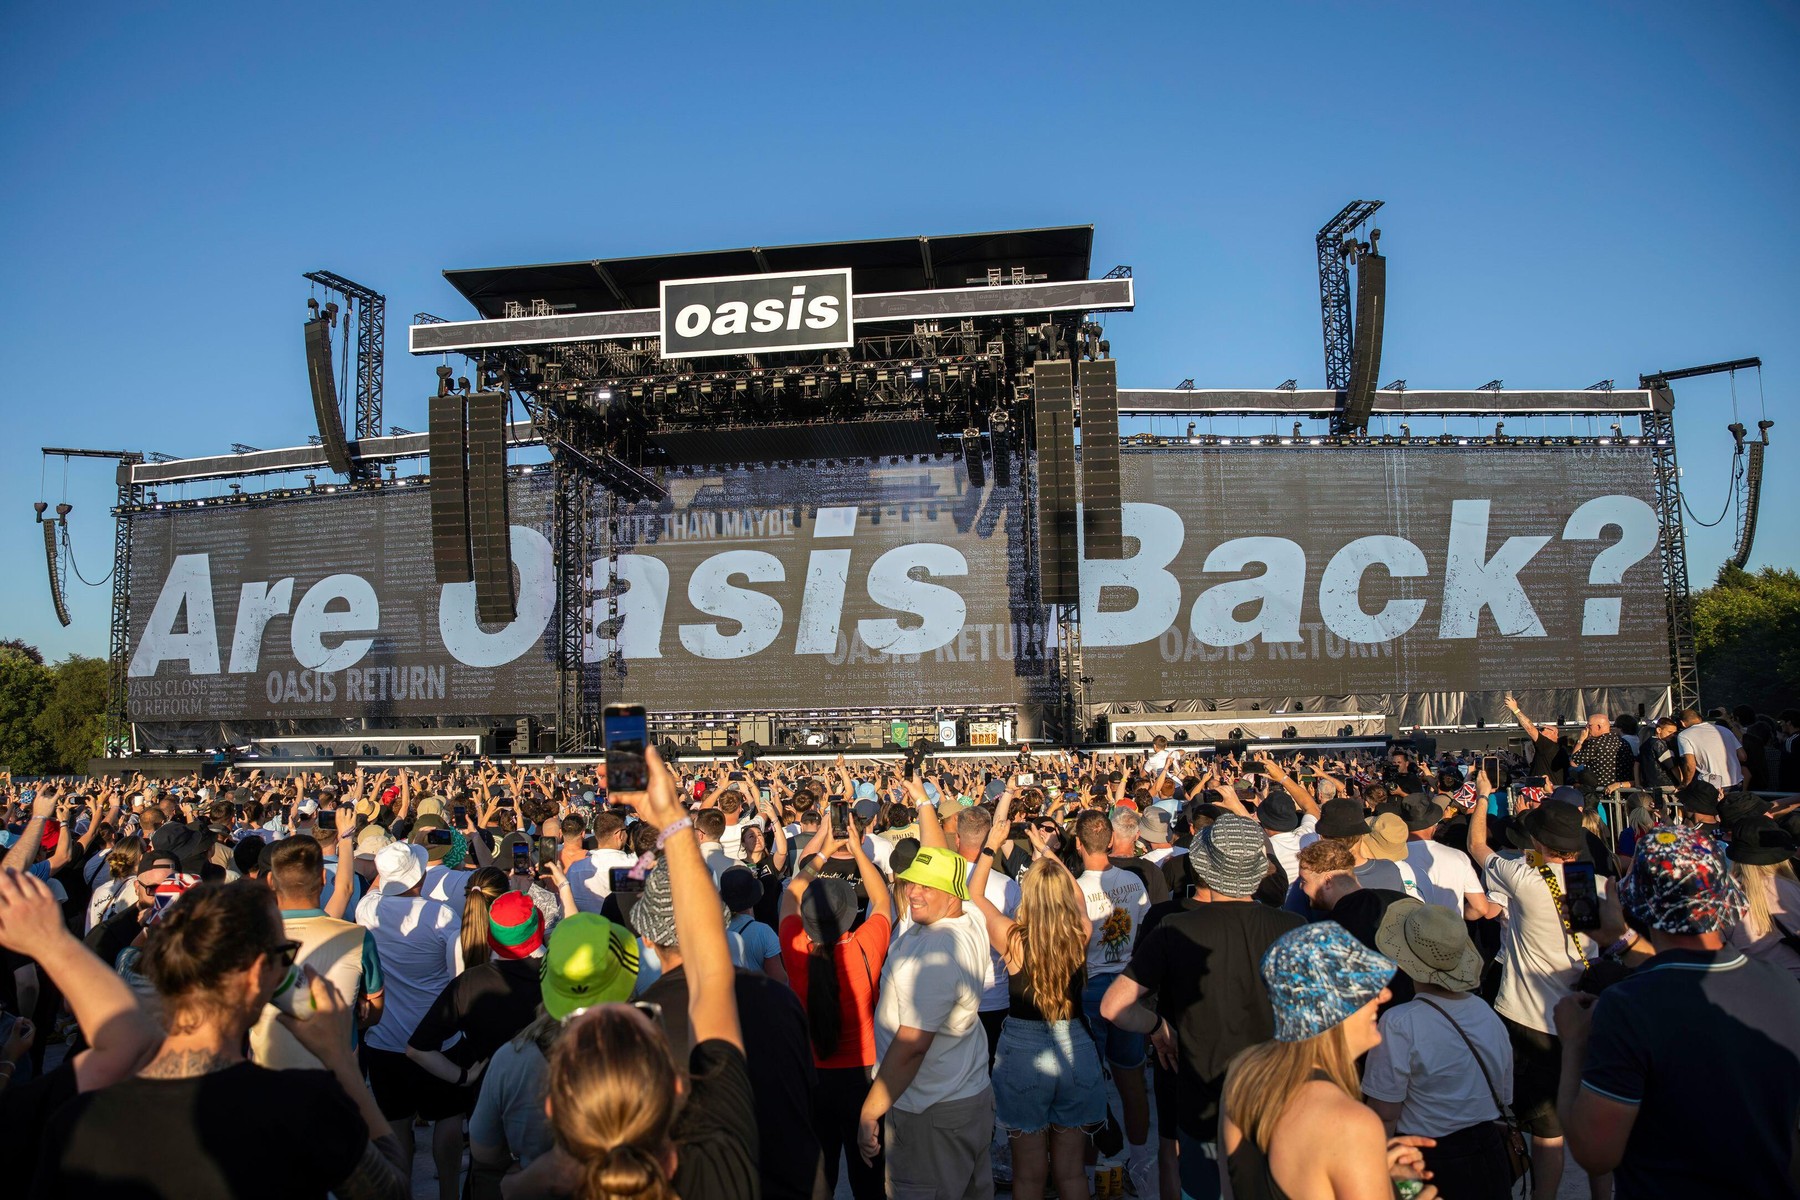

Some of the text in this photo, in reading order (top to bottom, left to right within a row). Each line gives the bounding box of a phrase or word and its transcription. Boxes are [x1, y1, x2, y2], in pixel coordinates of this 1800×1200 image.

[675, 285, 840, 338] oasis
[660, 511, 716, 540] THAN
[722, 508, 795, 537] MAYBE
[128, 553, 380, 677] Are
[1045, 494, 1660, 648] Back?
[165, 678, 209, 696] CLOSE
[265, 669, 338, 704] OASIS
[346, 664, 446, 702] RETURN
[144, 697, 203, 716] REFORM
